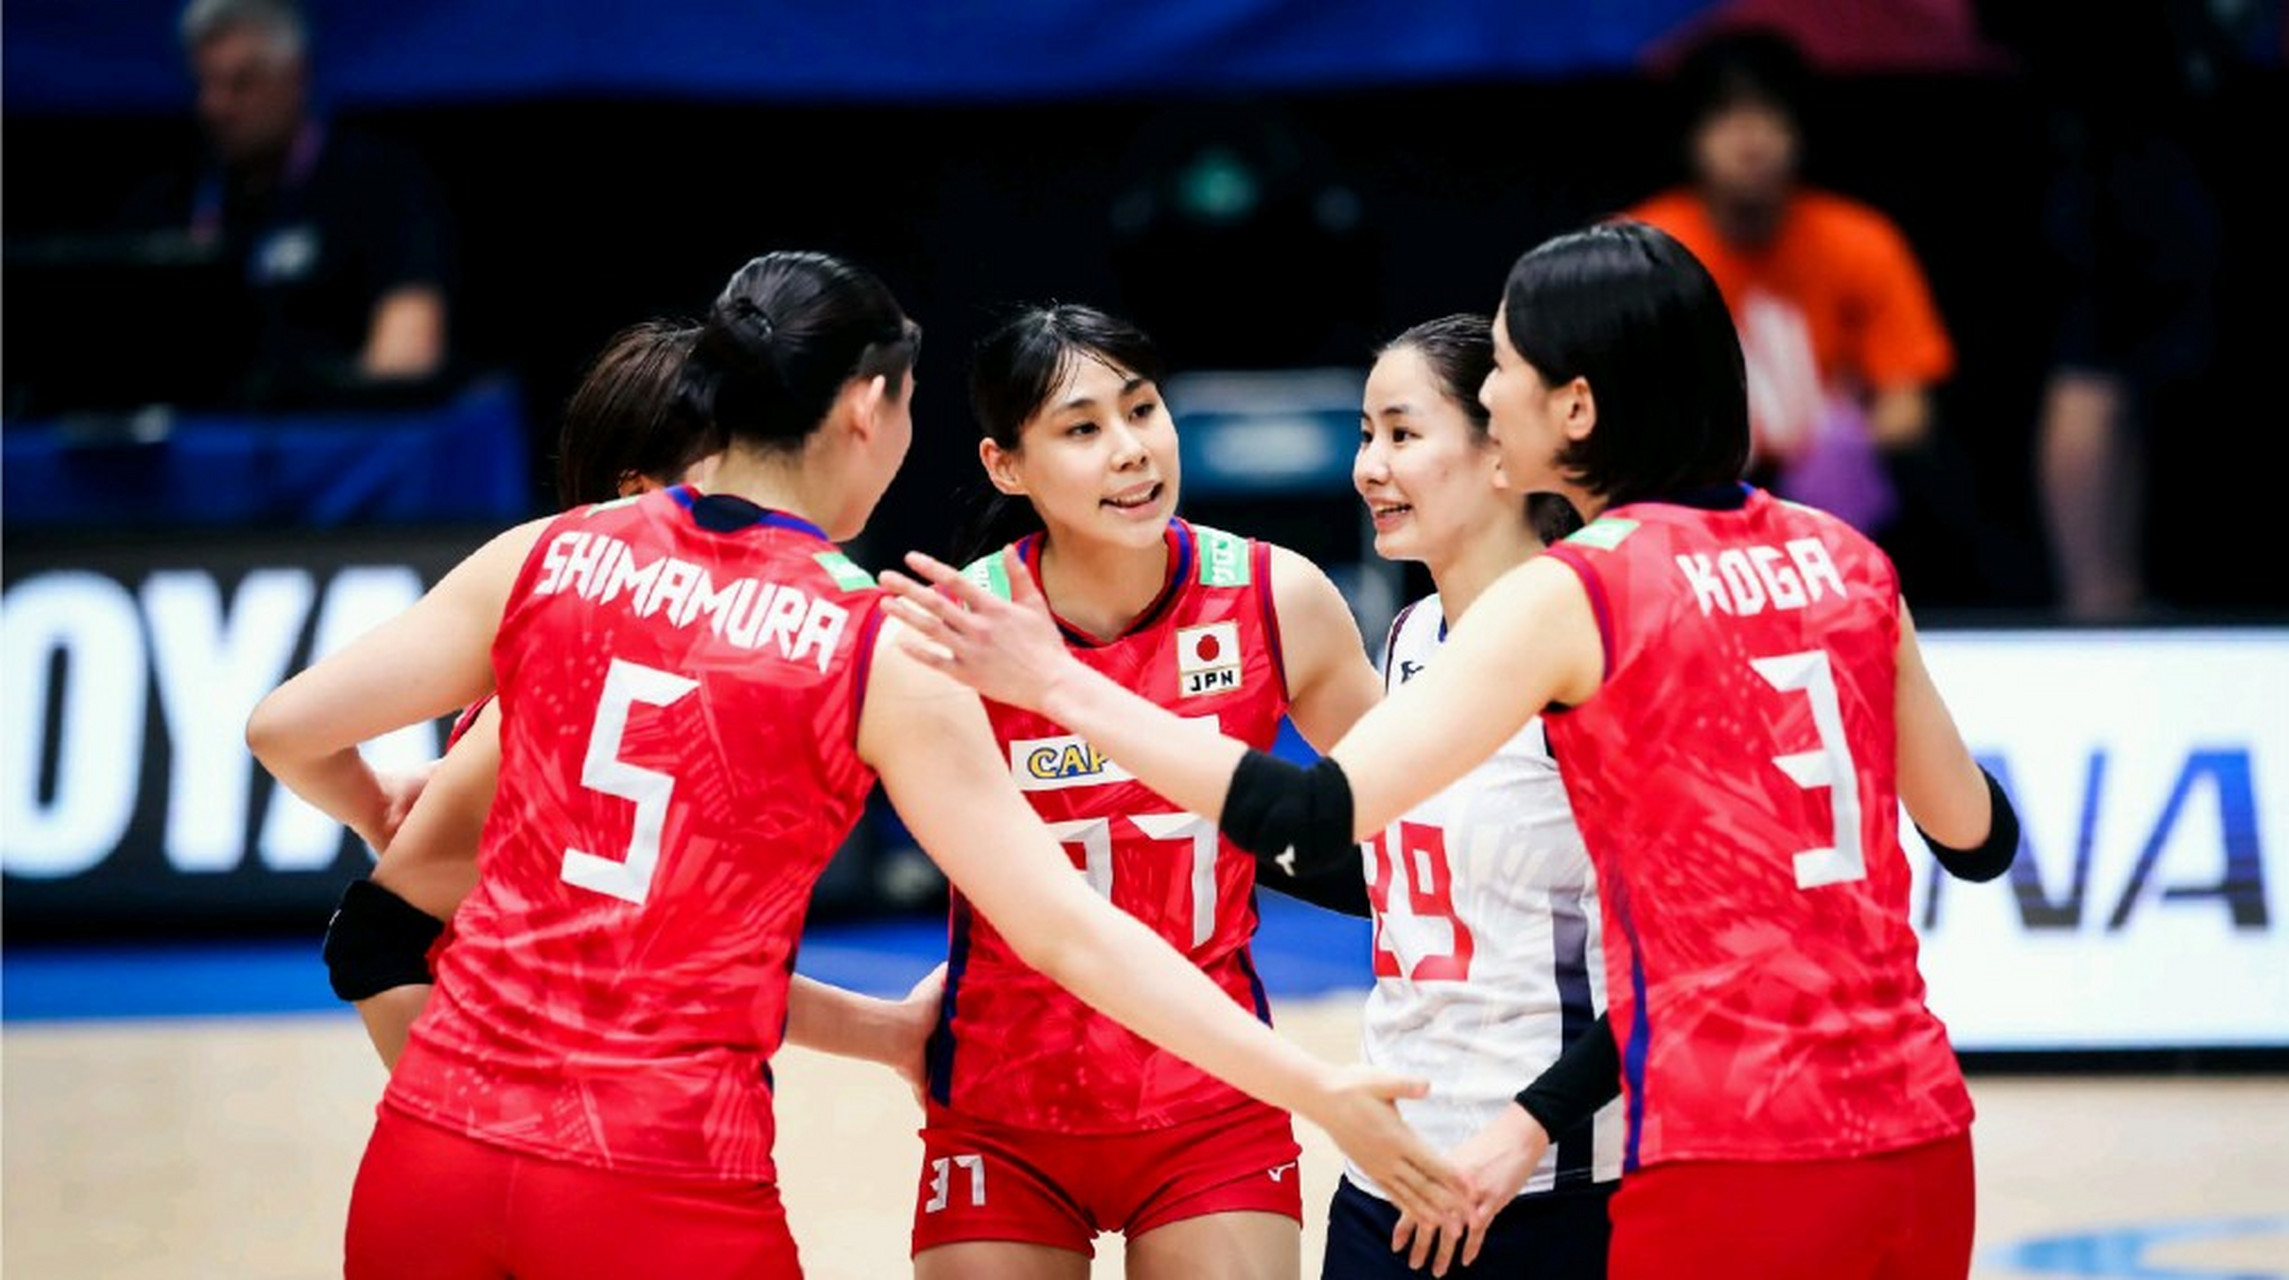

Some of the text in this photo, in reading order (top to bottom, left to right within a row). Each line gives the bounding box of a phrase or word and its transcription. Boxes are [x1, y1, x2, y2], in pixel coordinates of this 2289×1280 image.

[534, 530, 849, 675] SHIMAMURA
[1676, 537, 1847, 617] KOGA
[1190, 669, 1236, 692] JPN
[559, 657, 701, 906] 5
[1750, 649, 1866, 889] 3
[925, 1153, 987, 1214] 37
